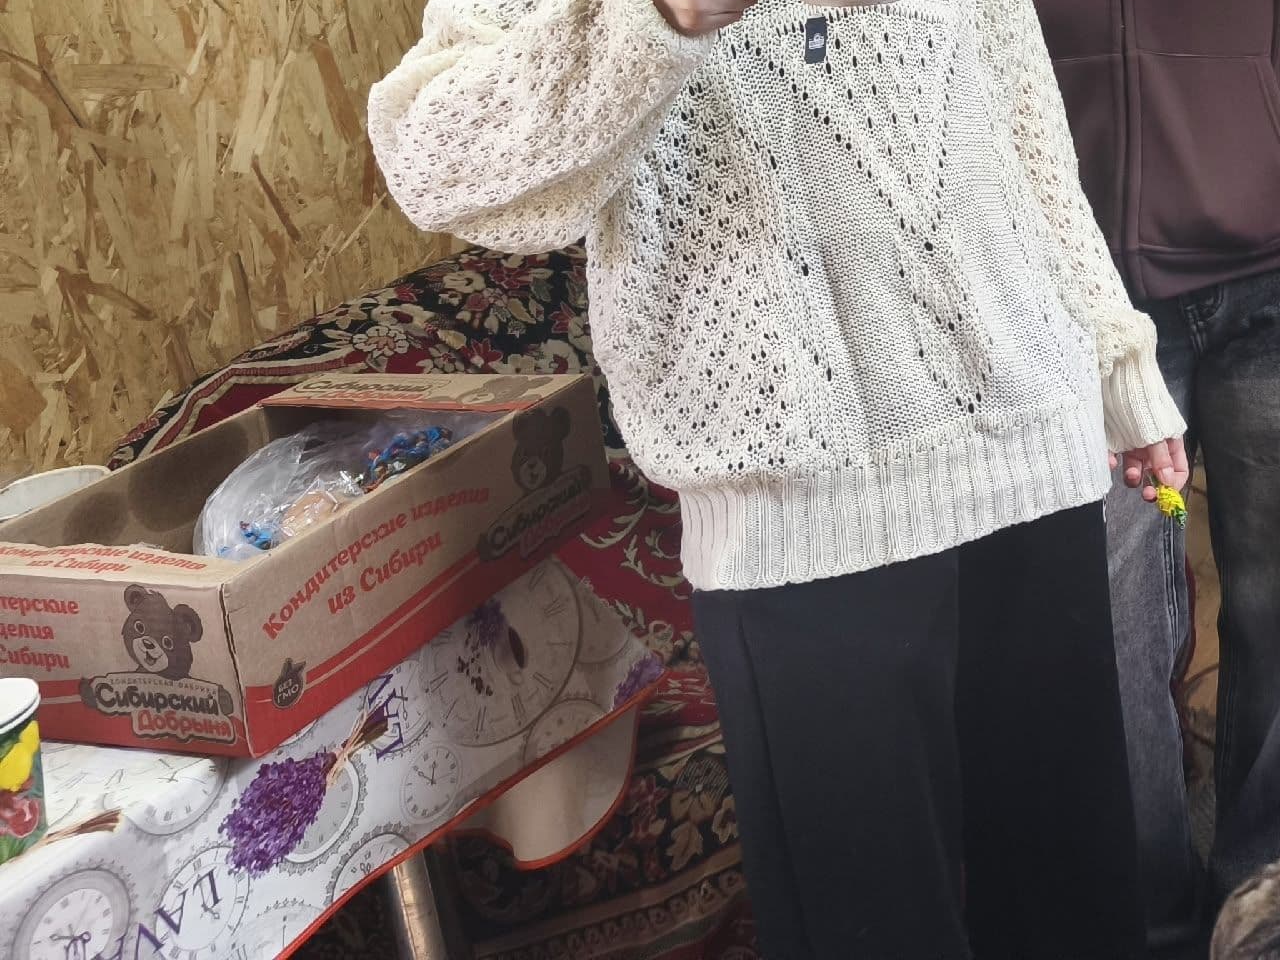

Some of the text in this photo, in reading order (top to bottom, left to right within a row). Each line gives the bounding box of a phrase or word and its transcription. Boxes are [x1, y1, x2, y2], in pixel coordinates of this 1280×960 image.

[54, 557, 133, 573] Сибири
[129, 551, 207, 571] изделия
[262, 487, 490, 640] Кондитерские изделия
[328, 532, 443, 615] из Сибири
[94, 682, 220, 715] Сибирский
[277, 683, 299, 705] ГМО
[137, 709, 233, 738] Добрыня
